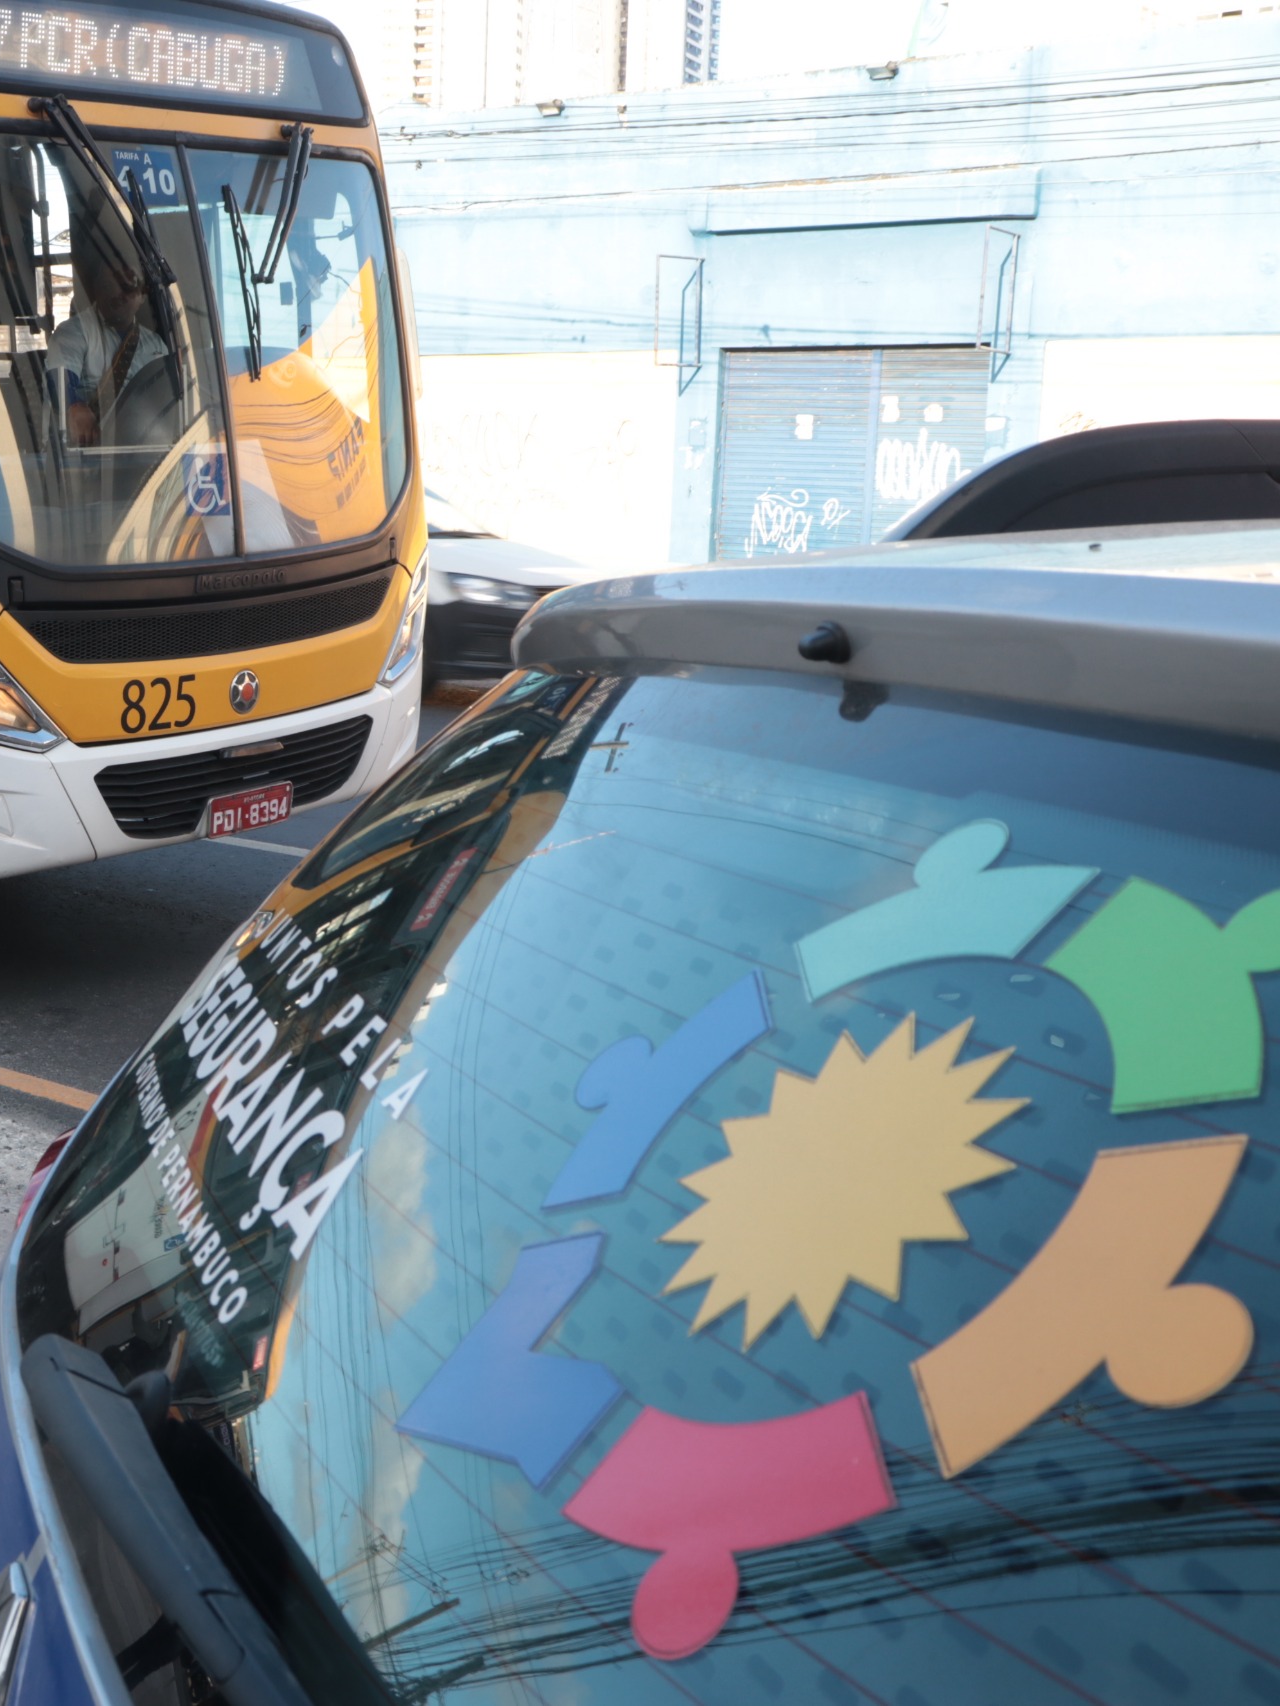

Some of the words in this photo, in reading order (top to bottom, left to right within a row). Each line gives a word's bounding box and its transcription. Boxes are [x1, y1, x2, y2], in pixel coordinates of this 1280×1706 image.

[20, 11, 97, 76] PCR
[115, 151, 140, 160] TARIFA
[121, 674, 196, 734] 825
[254, 908, 338, 1009] JUNTOS
[321, 993, 429, 1120] PELA
[136, 1052, 169, 1130] GOVERNO
[180, 956, 364, 1261] SEGURANÇA
[148, 1114, 175, 1158] DE
[157, 1145, 248, 1324] PERNAMBUCO
